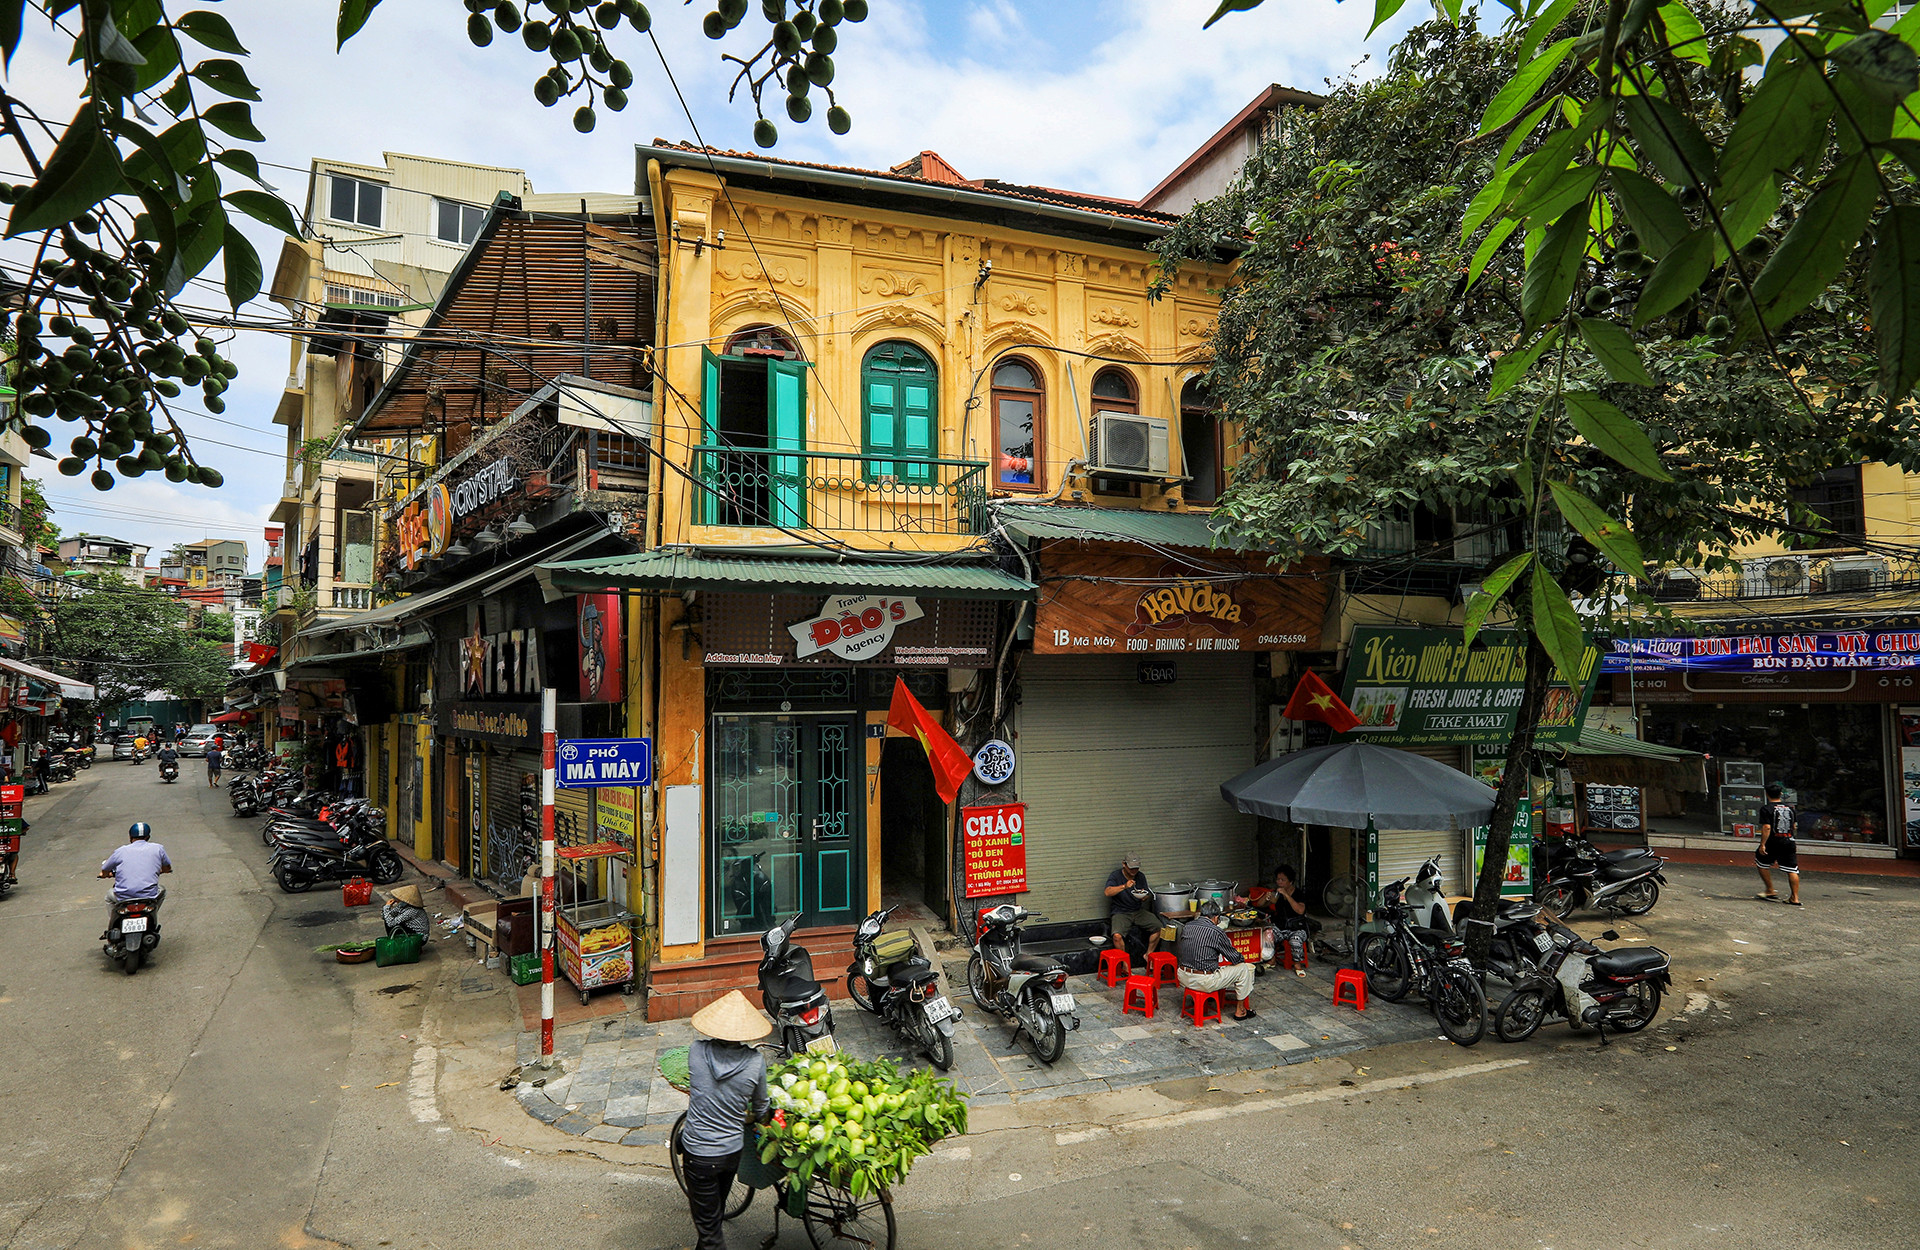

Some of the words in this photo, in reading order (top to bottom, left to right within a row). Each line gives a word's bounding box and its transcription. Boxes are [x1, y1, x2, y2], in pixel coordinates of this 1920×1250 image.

[456, 457, 514, 517] CRYSTAL
[836, 594, 867, 609] Travel
[1141, 579, 1241, 625] Havana
[845, 632, 885, 655] Agency
[1053, 630, 1070, 646] 1B
[1093, 635, 1116, 648] Mây
[1126, 639, 1148, 651] FOOD
[1155, 638, 1186, 651] DRINKS
[1196, 638, 1213, 650] LIVE
[1214, 638, 1240, 650] MUSIC
[1693, 636, 1731, 655] BÚN
[1837, 631, 1869, 652] MỲ
[1365, 635, 1417, 684] Kiên
[1416, 638, 1453, 683] NƯỚC
[1753, 656, 1787, 668] BÚN
[1792, 655, 1828, 669] ĐẬU
[1833, 652, 1873, 667] MẮM
[1879, 653, 1916, 666] TÔM
[1151, 667, 1174, 681] BAR
[1879, 677, 1890, 687] Ô
[1894, 676, 1913, 687] TÔ
[1409, 689, 1448, 708] FRESH
[1448, 688, 1482, 708] JUICE
[1482, 688, 1492, 707] &
[1494, 688, 1525, 707] COFF
[1430, 716, 1461, 728] TAKE
[1467, 715, 1504, 728] AWAY
[589, 745, 619, 757] PHỐ
[1478, 744, 1508, 754] COFF
[567, 760, 596, 780] MÃ
[602, 759, 641, 779] MÂY
[966, 809, 1022, 837] CHÁO
[985, 837, 1009, 846] XANH
[986, 849, 1003, 857] ĐEN
[972, 860, 989, 870] ĐẬU
